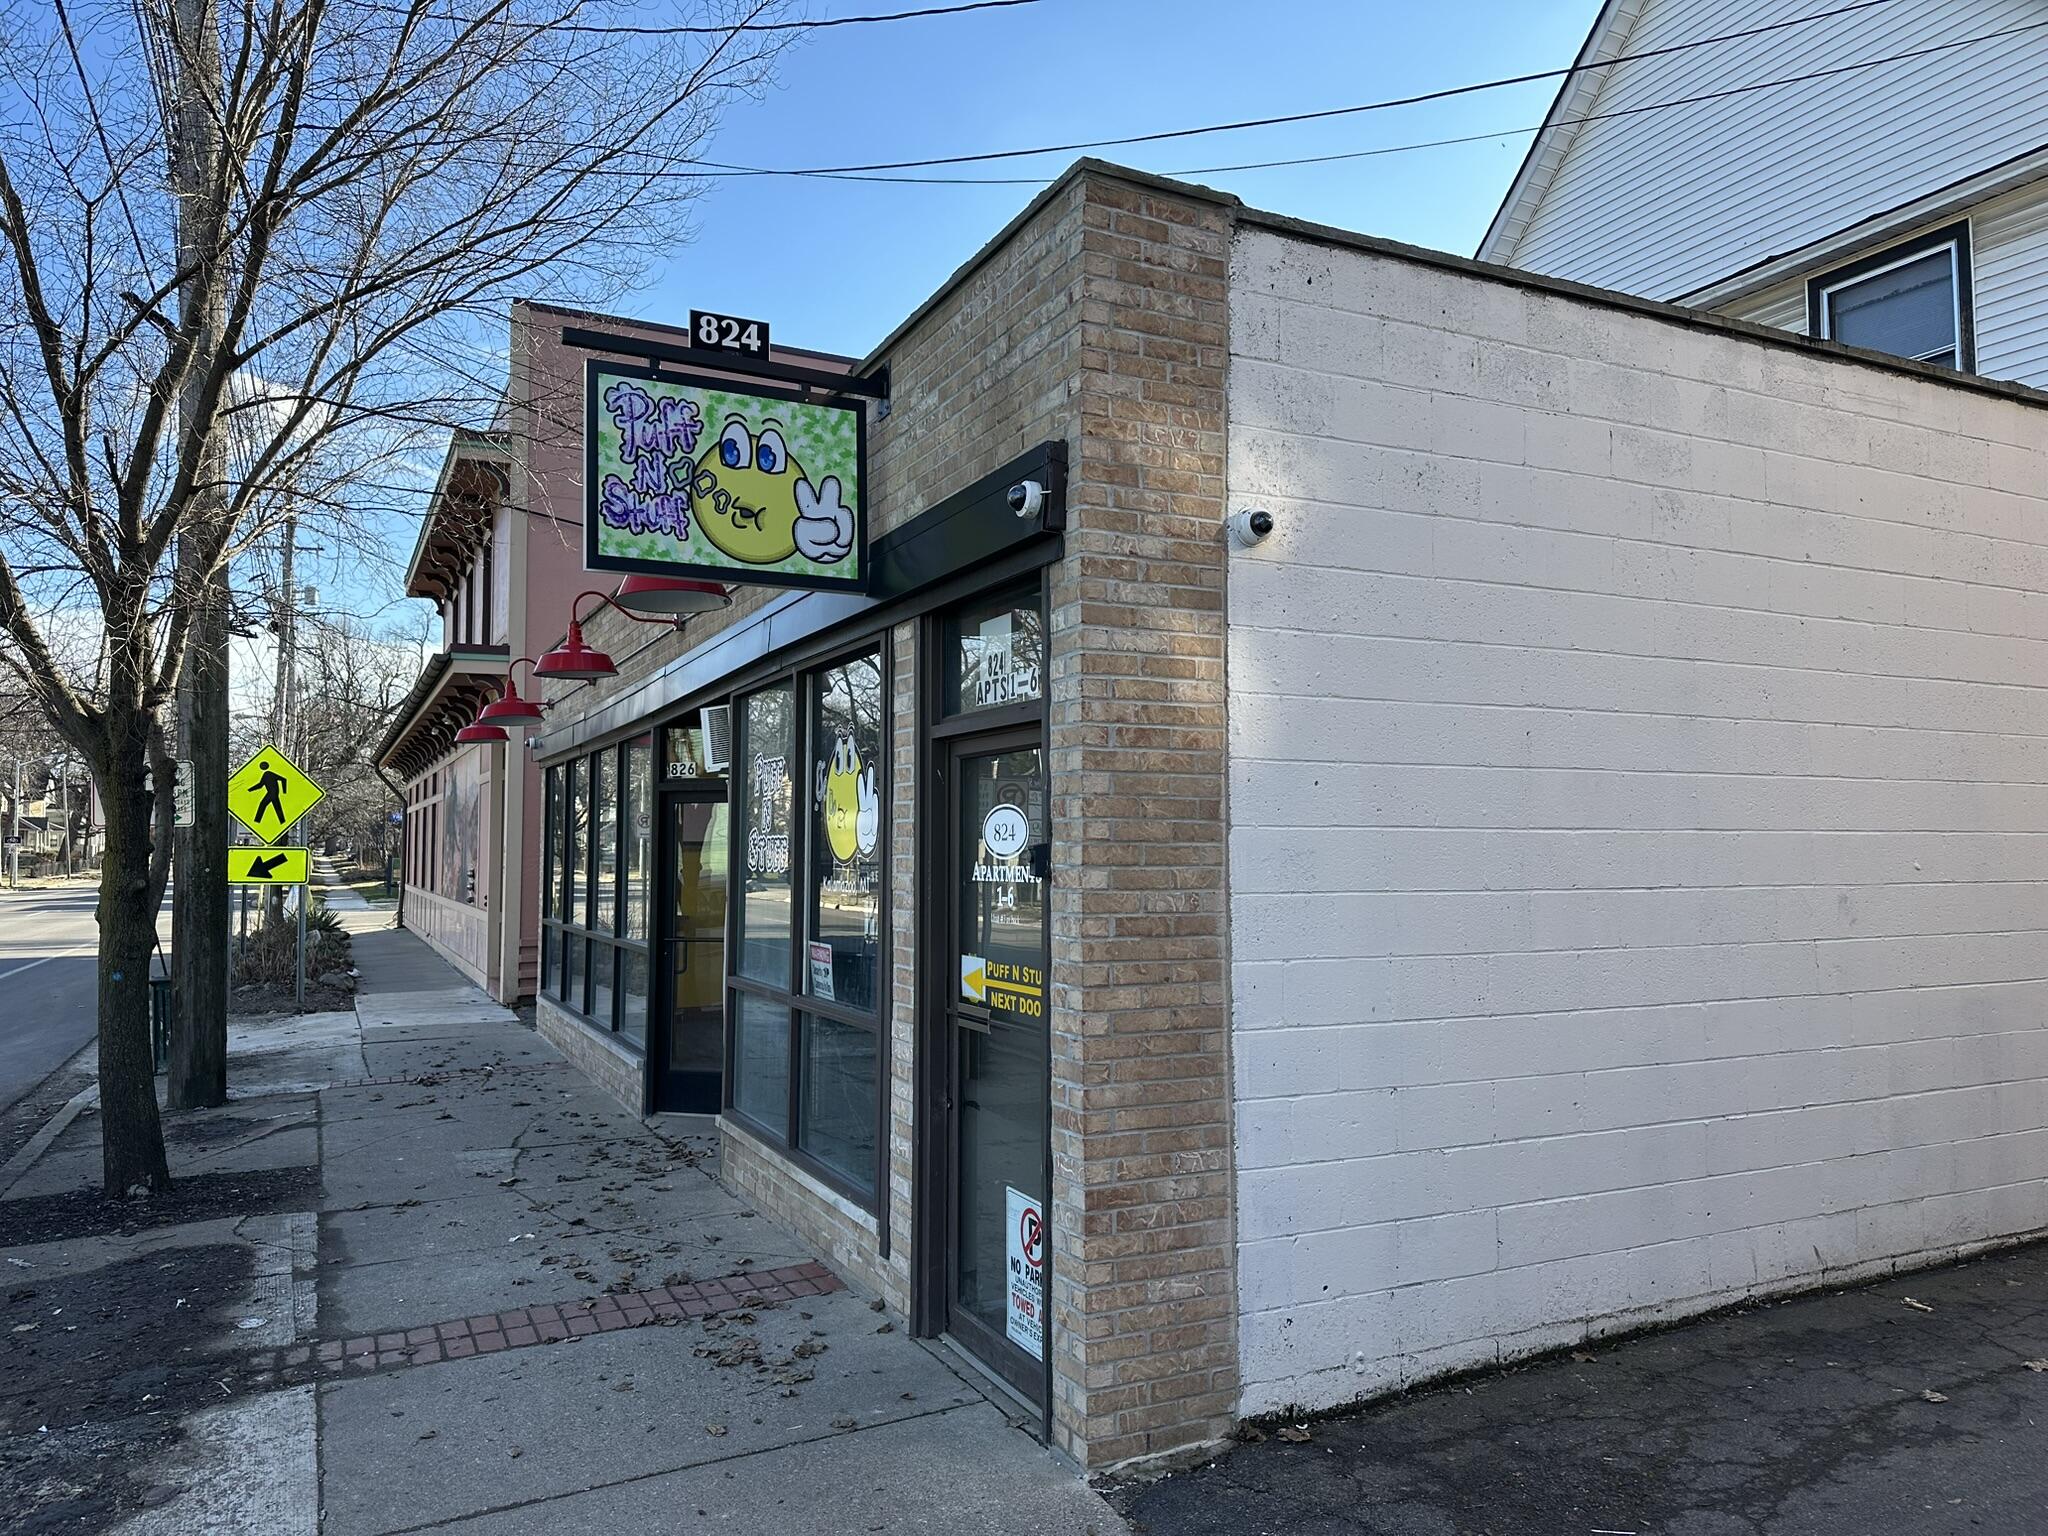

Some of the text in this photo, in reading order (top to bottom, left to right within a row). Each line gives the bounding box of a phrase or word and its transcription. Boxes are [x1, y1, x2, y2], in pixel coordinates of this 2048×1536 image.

[699, 315, 761, 352] 824
[630, 450, 668, 495] N
[987, 651, 1006, 677] 824
[976, 676, 1007, 705] APTS
[671, 763, 695, 775] 826
[993, 823, 1016, 841] 824
[972, 861, 1042, 883] APARTMEN
[996, 886, 1014, 908] 1-6
[987, 961, 1010, 979] PUFF
[1012, 965, 1020, 981] N
[991, 991, 1016, 1011] NEXT
[1010, 1256, 1021, 1275] NO
[1012, 1292, 1035, 1319] TOWED
